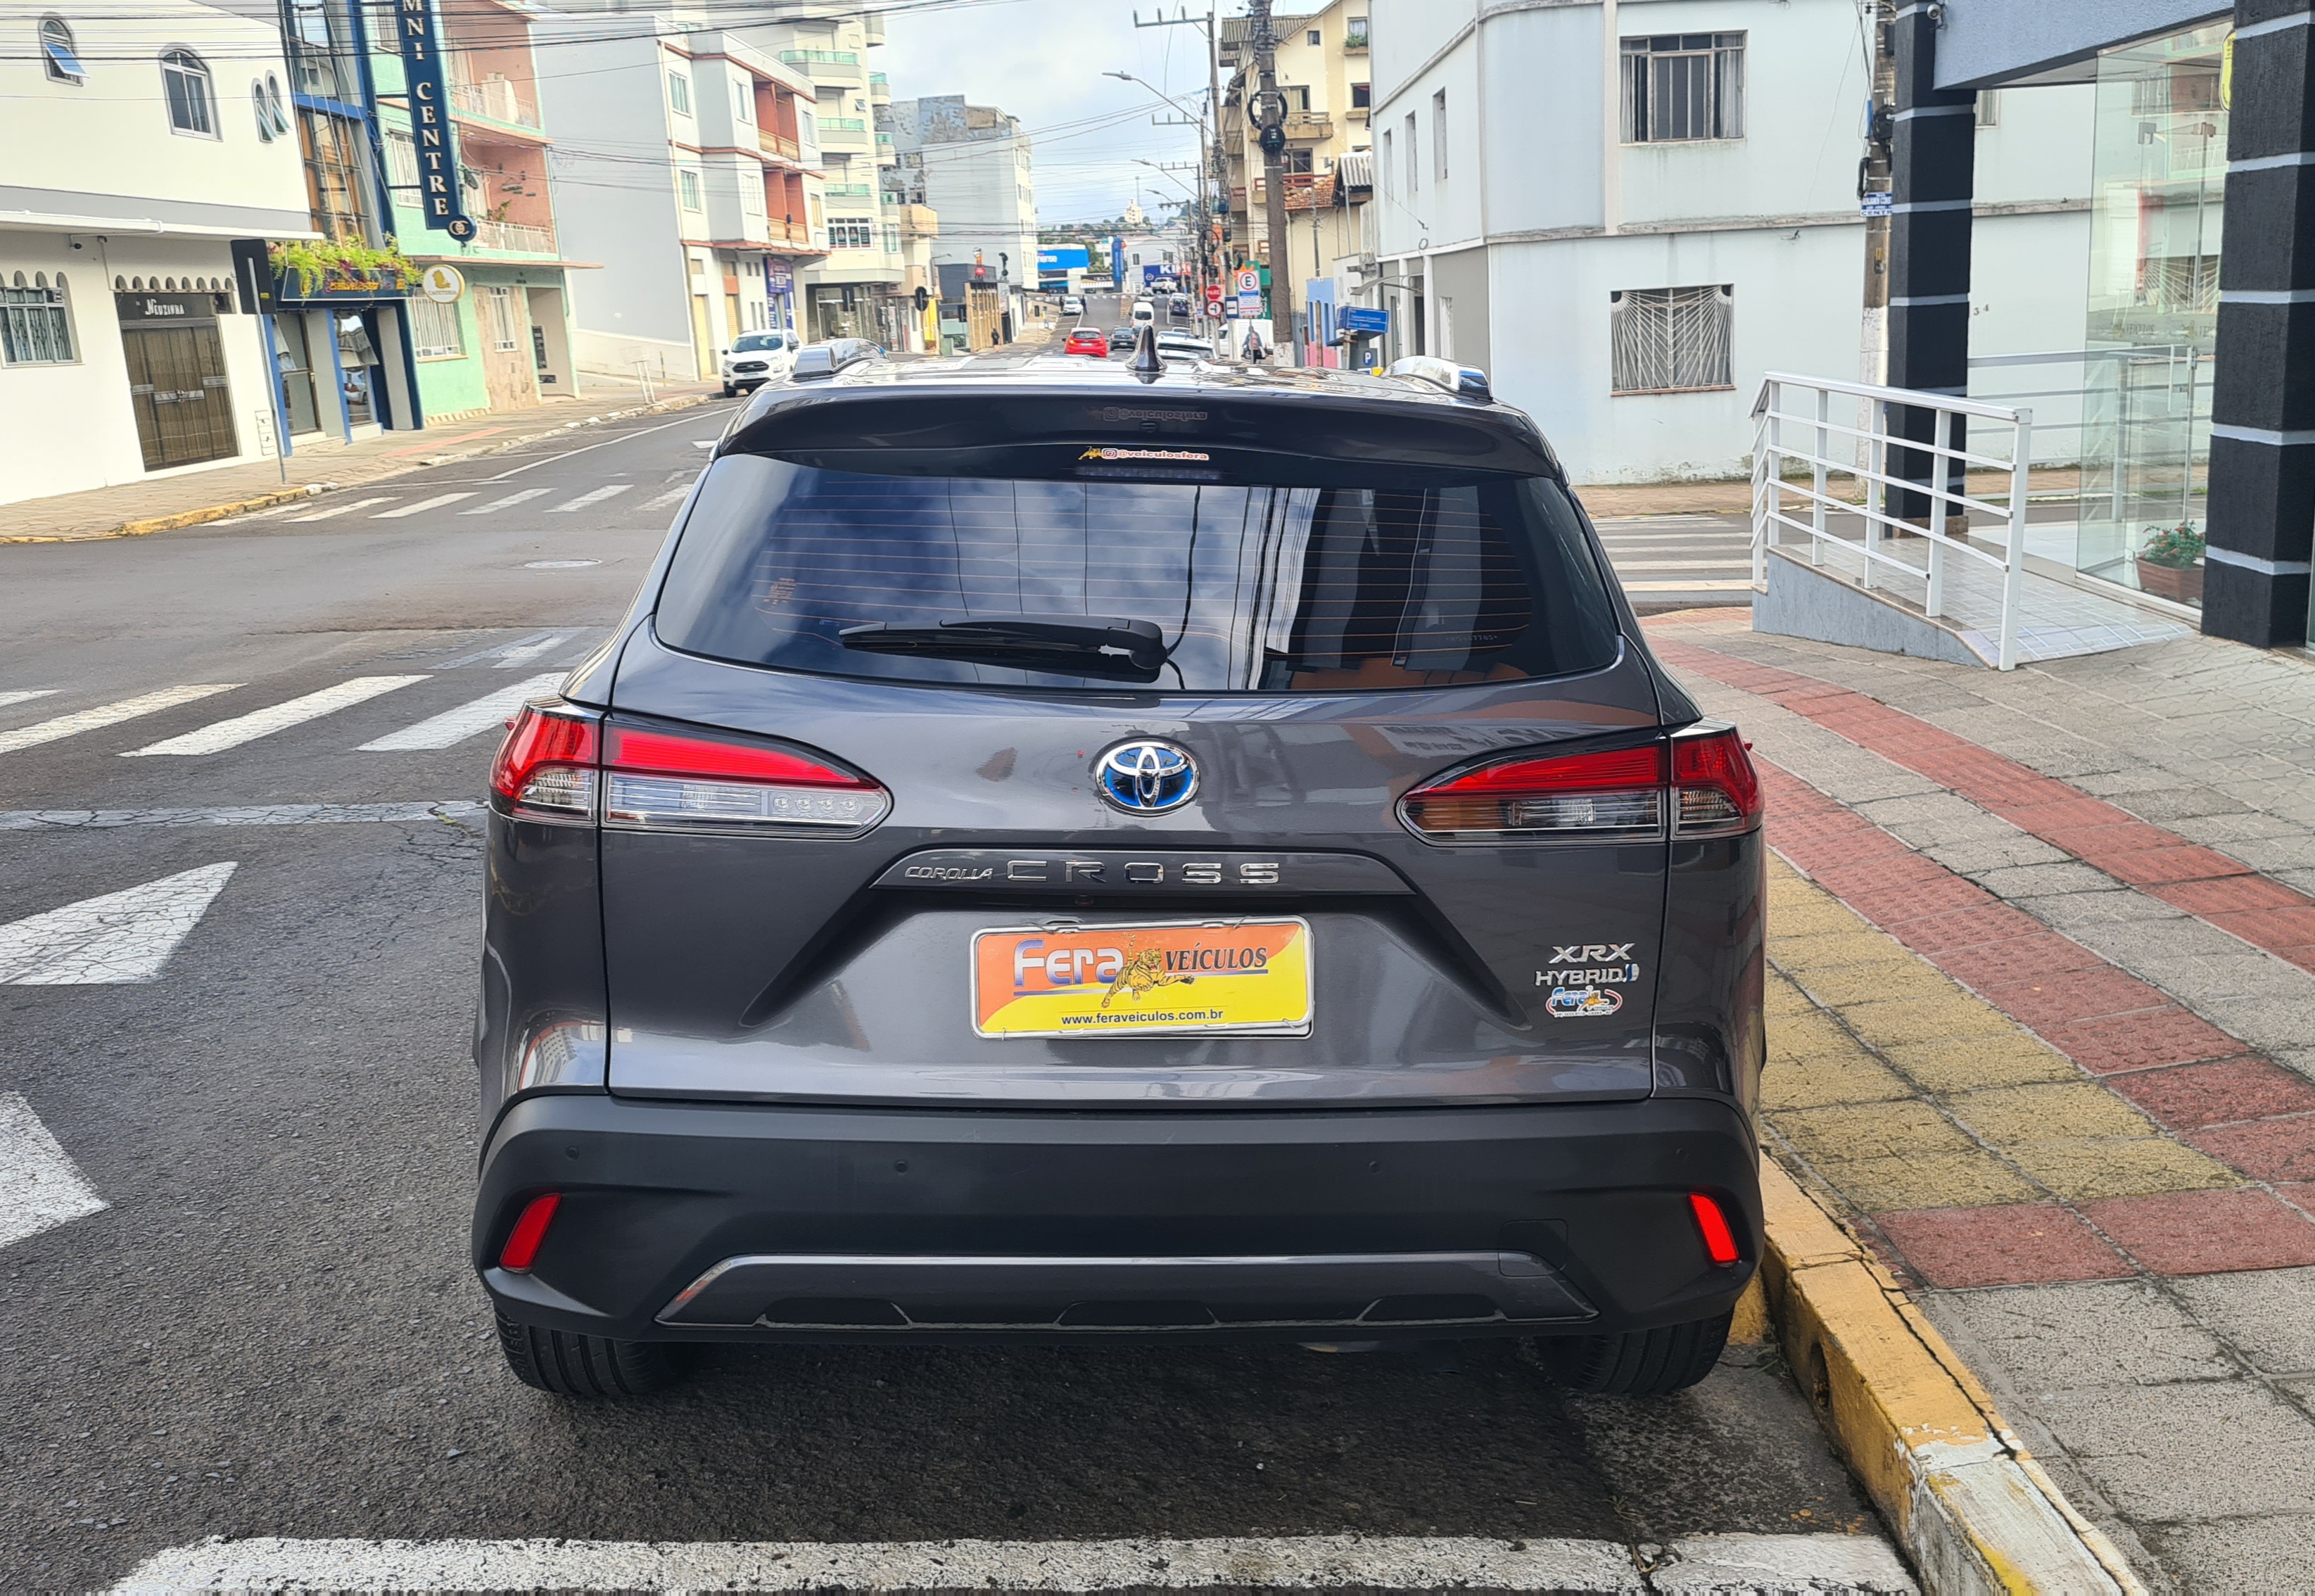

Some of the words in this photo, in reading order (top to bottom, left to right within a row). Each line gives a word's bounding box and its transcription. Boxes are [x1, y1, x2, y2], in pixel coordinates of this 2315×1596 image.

[416, 82, 449, 215] CENTRE
[1245, 276, 1252, 286] E
[1364, 352, 1372, 364] P
[1117, 448, 1210, 461] @veiculosfera
[905, 866, 994, 880] COROLLA
[1007, 860, 1279, 884] CROSS
[1014, 938, 1124, 987] Fera
[1165, 942, 1268, 972] VEÍCULOS
[1549, 943, 1636, 964] XRX
[1535, 968, 1624, 986] HYBRID
[1061, 1009, 1224, 1025] www.feraveiculos.com.br
